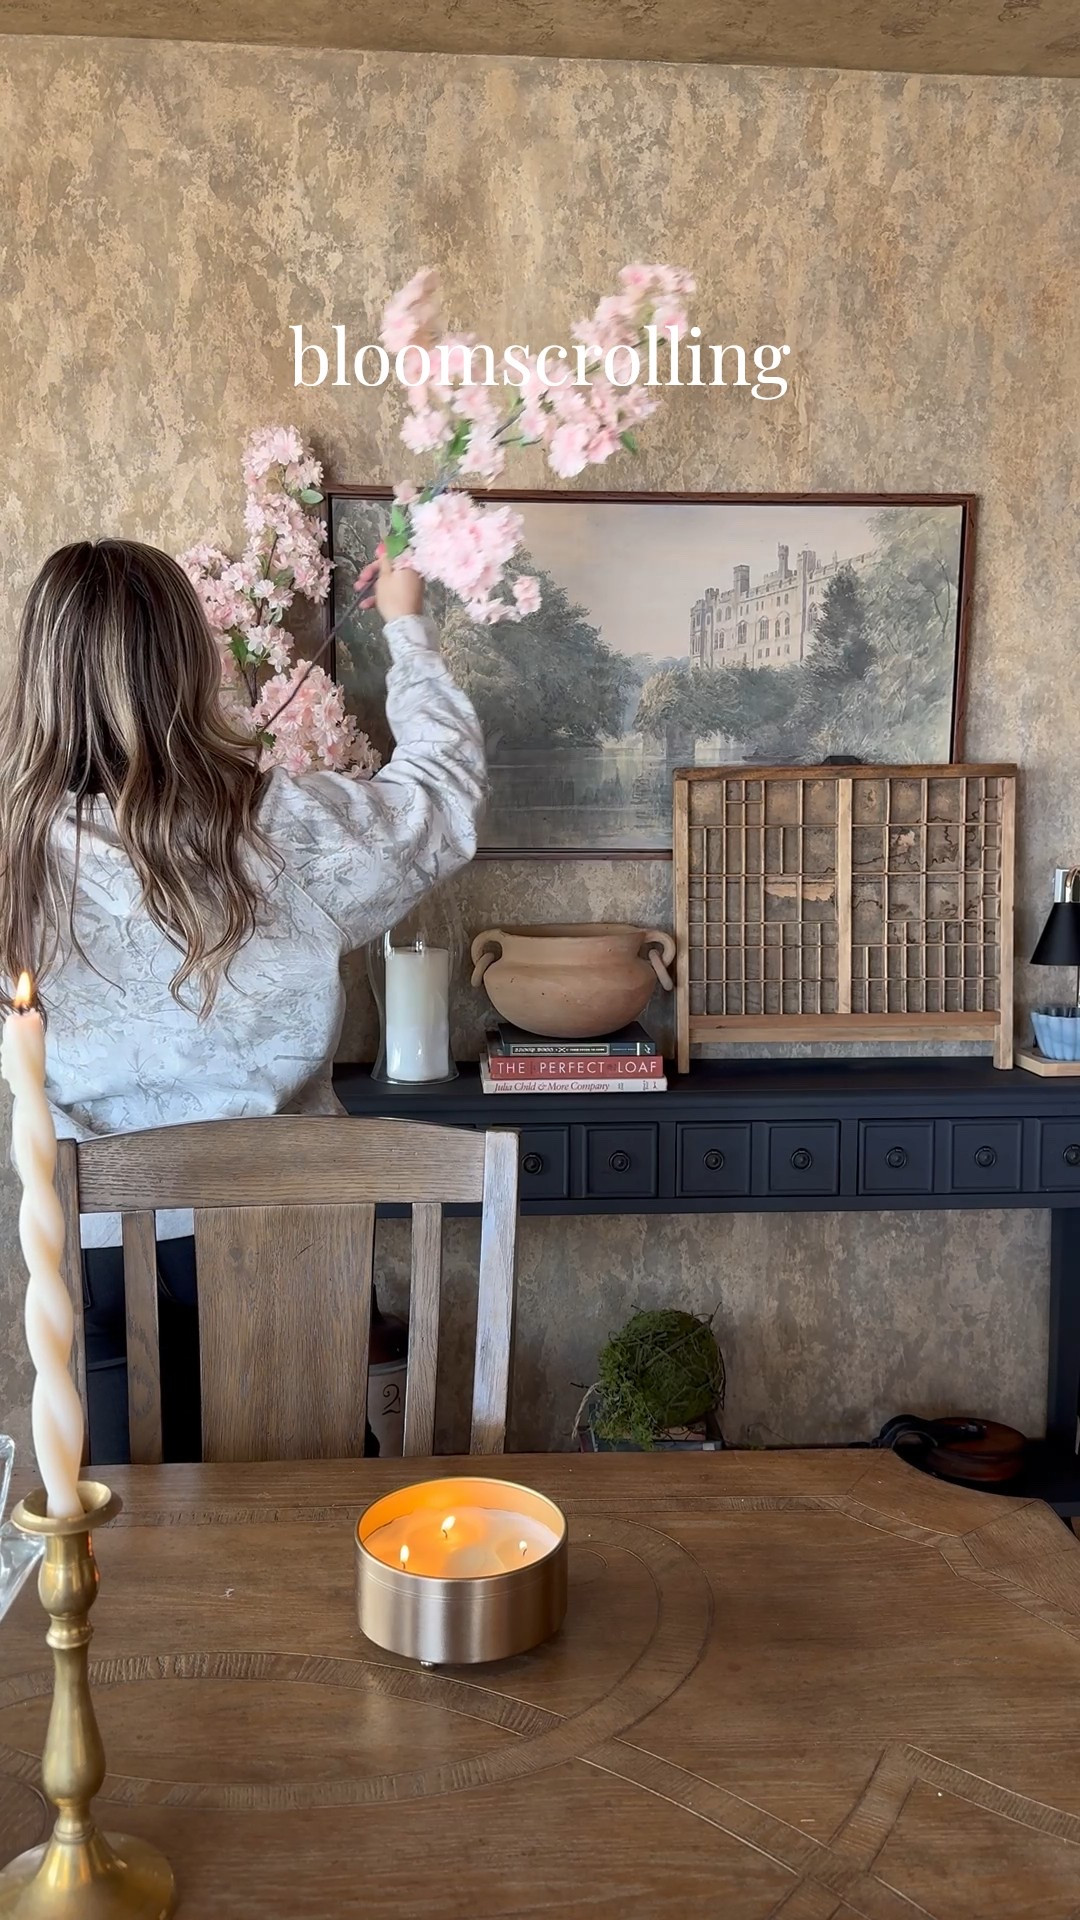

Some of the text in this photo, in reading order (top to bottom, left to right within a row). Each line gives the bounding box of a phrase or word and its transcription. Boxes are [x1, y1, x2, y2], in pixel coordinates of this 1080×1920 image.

[497, 1060, 657, 1074] THE PERFECT LOAF
[494, 1082, 512, 1092] Julia
[514, 1081, 537, 1091] Child
[548, 1081, 570, 1090] More
[570, 1081, 610, 1092] Company
[382, 1383, 401, 1416] 2
